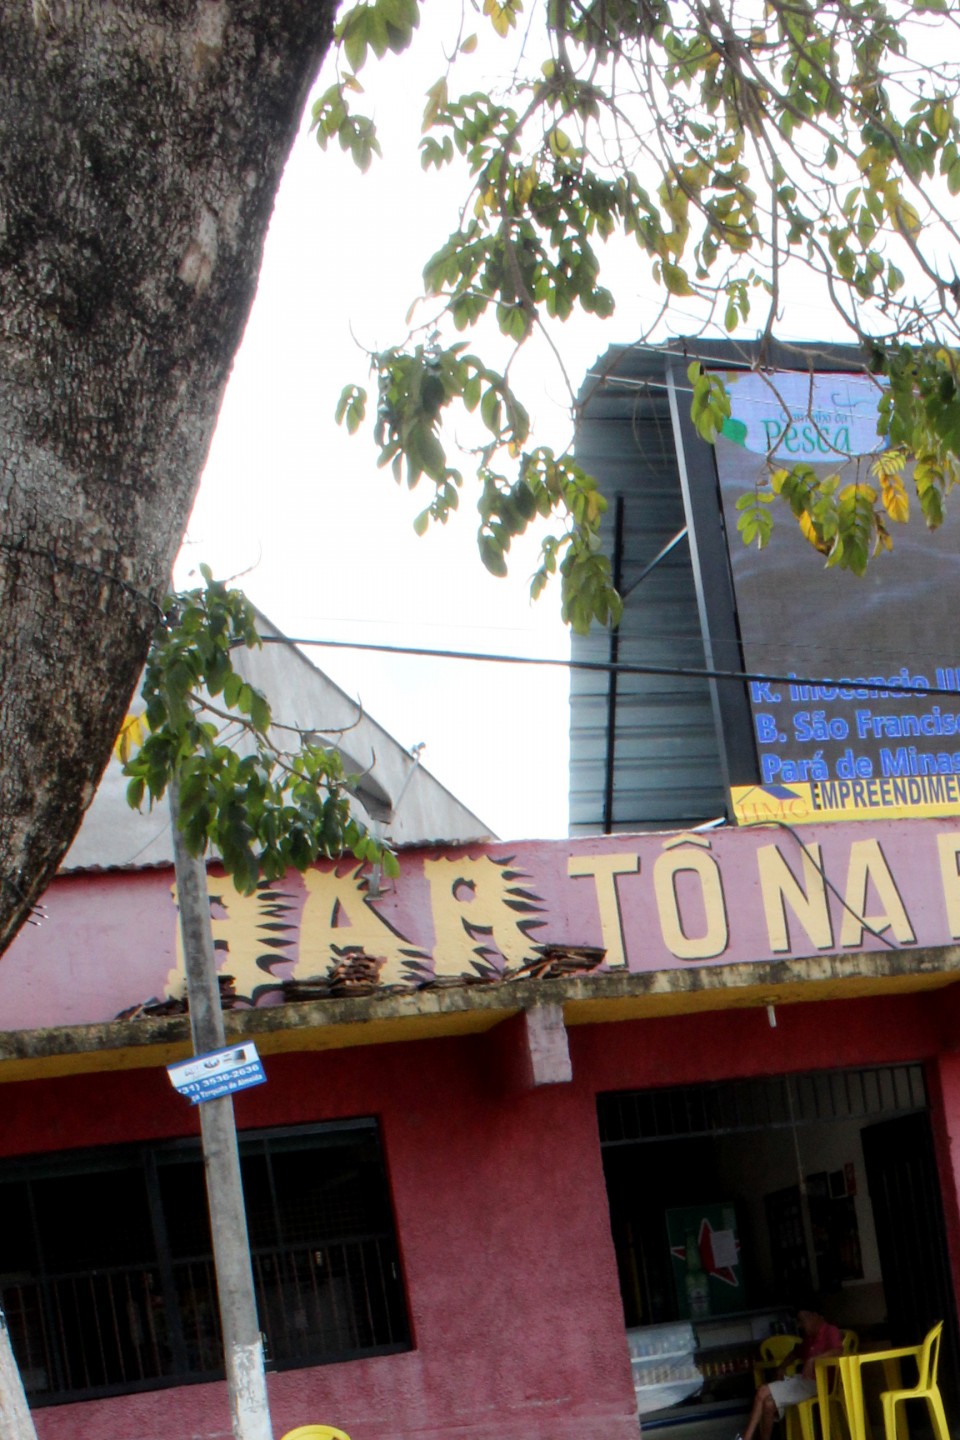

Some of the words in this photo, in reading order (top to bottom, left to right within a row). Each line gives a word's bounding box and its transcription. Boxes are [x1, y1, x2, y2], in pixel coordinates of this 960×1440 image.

[761, 418, 850, 454] Pesca
[755, 713, 788, 744] B.
[793, 709, 850, 742] São
[760, 750, 829, 784] Pará
[835, 748, 873, 779] de
[165, 855, 549, 1002] BAR
[568, 834, 728, 970] TÔ
[756, 838, 916, 953] NA
